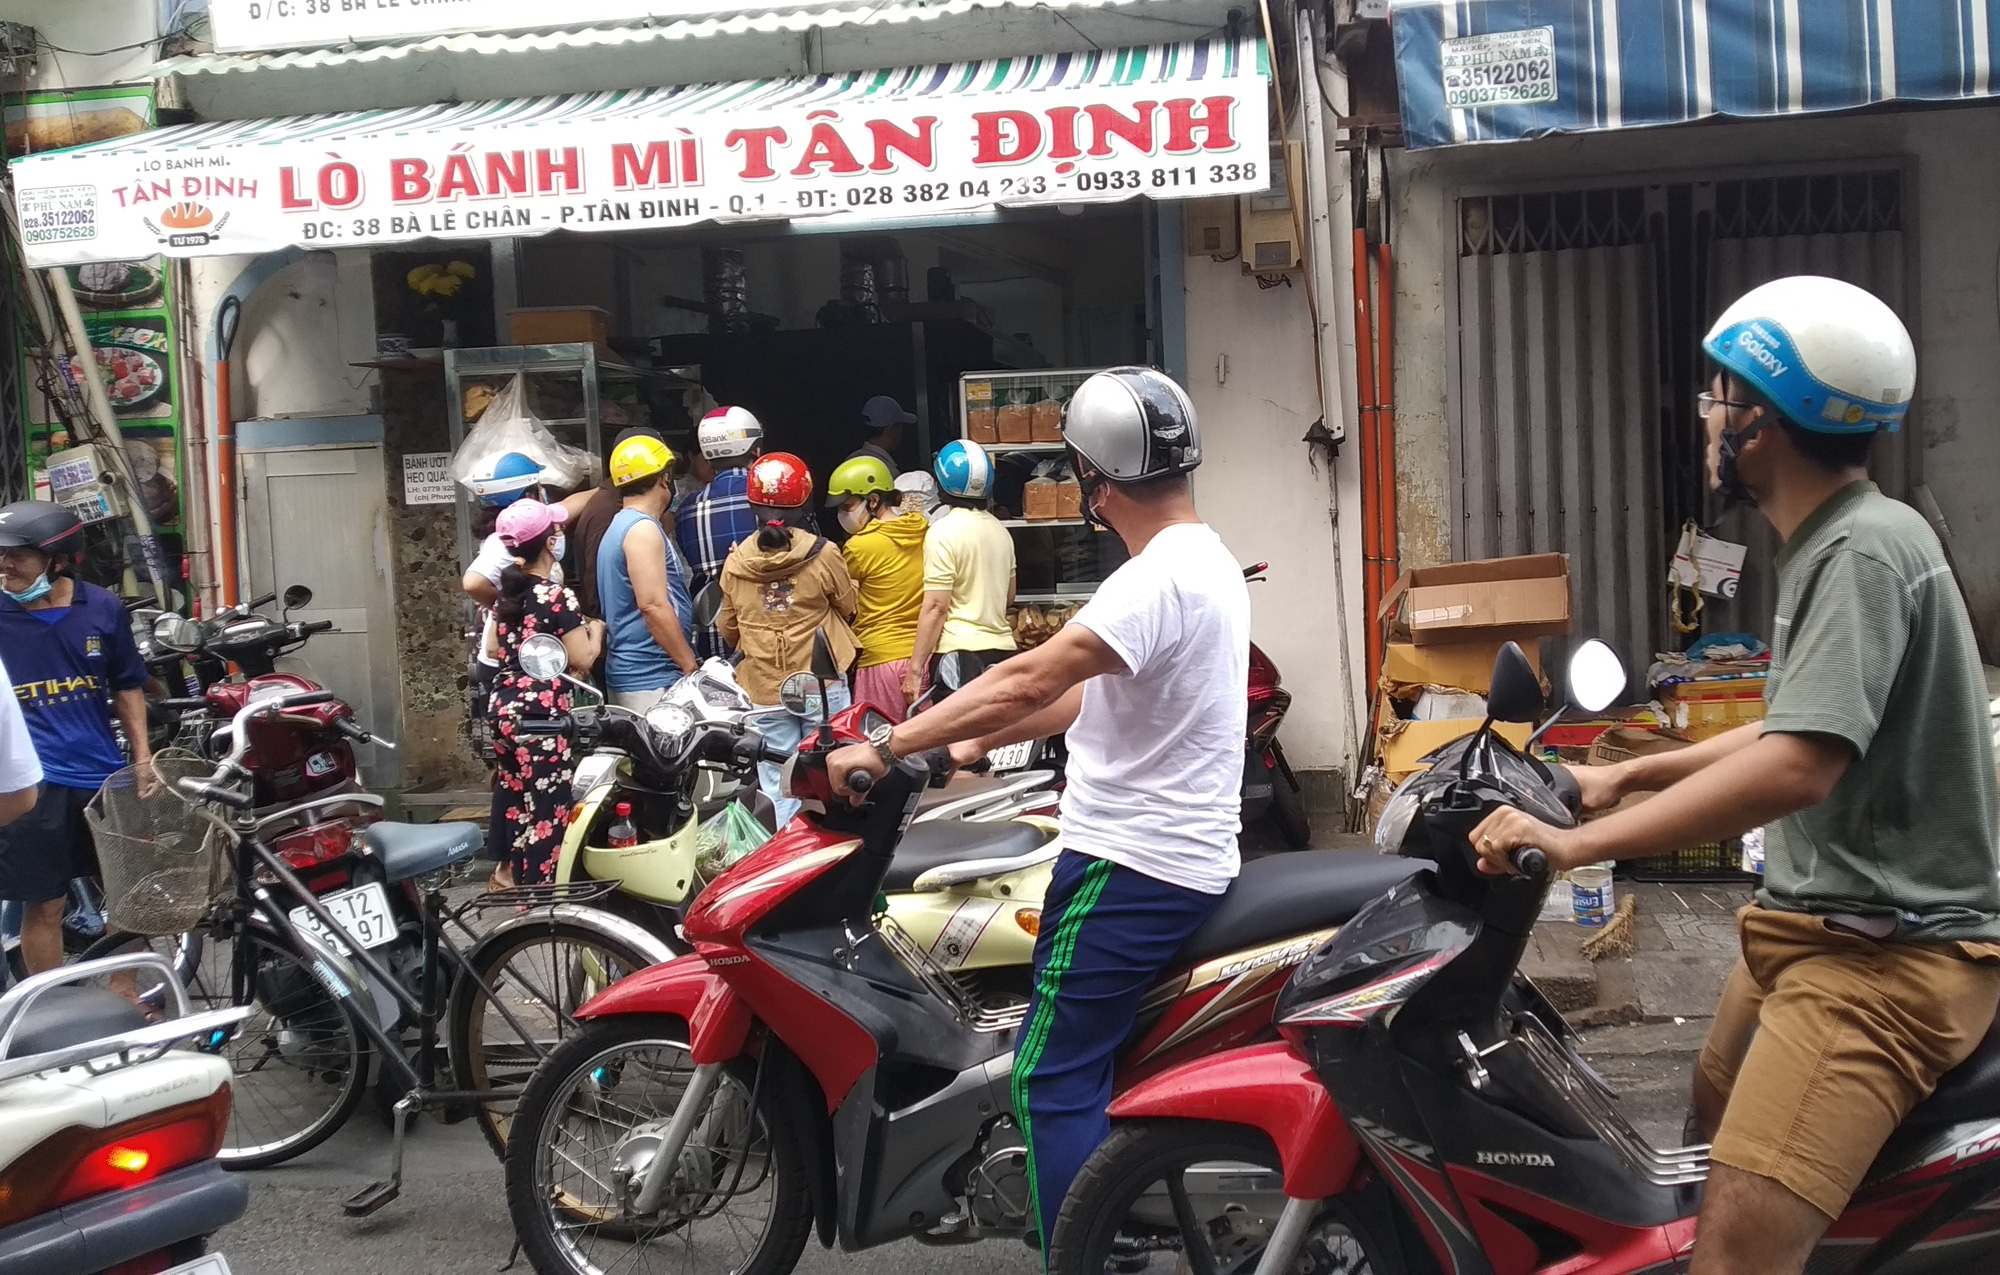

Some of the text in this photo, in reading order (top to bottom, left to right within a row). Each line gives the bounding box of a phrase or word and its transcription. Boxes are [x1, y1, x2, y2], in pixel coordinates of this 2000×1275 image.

[307, 0, 331, 14] 38
[1499, 47, 1532, 61] NAM
[1462, 58, 1551, 87] 35122062
[1449, 82, 1550, 104] 0903752628
[279, 95, 1240, 212] LÒ BÁNH MÌ TÂN ĐỊNH
[112, 178, 173, 208] TÂN
[182, 176, 258, 200] ĐỊNH
[302, 219, 343, 240] ĐC:
[352, 217, 381, 236] 38
[390, 209, 422, 234] BÀ
[431, 208, 456, 232] LÊ
[465, 204, 531, 230] CHÂN
[560, 200, 631, 224] P.TÂN
[796, 188, 837, 208] ĐT:
[846, 185, 893, 207] 028
[903, 182, 950, 203] 382
[960, 180, 991, 201] 04
[1000, 175, 1047, 196] 233
[1076, 170, 1141, 191] 0933
[1151, 166, 1197, 187] 811
[1209, 162, 1257, 183] 338
[24, 209, 95, 229] 028.35122062
[26, 226, 95, 242] 0903752628
[186, 234, 205, 245] 1978
[1739, 330, 1788, 378] Galaxy
[405, 456, 427, 469] BÁNH
[406, 472, 424, 483] HEO
[306, 892, 373, 932] 5-T2
[711, 954, 751, 966] HONDA
[1476, 1151, 1555, 1167] HONDA
